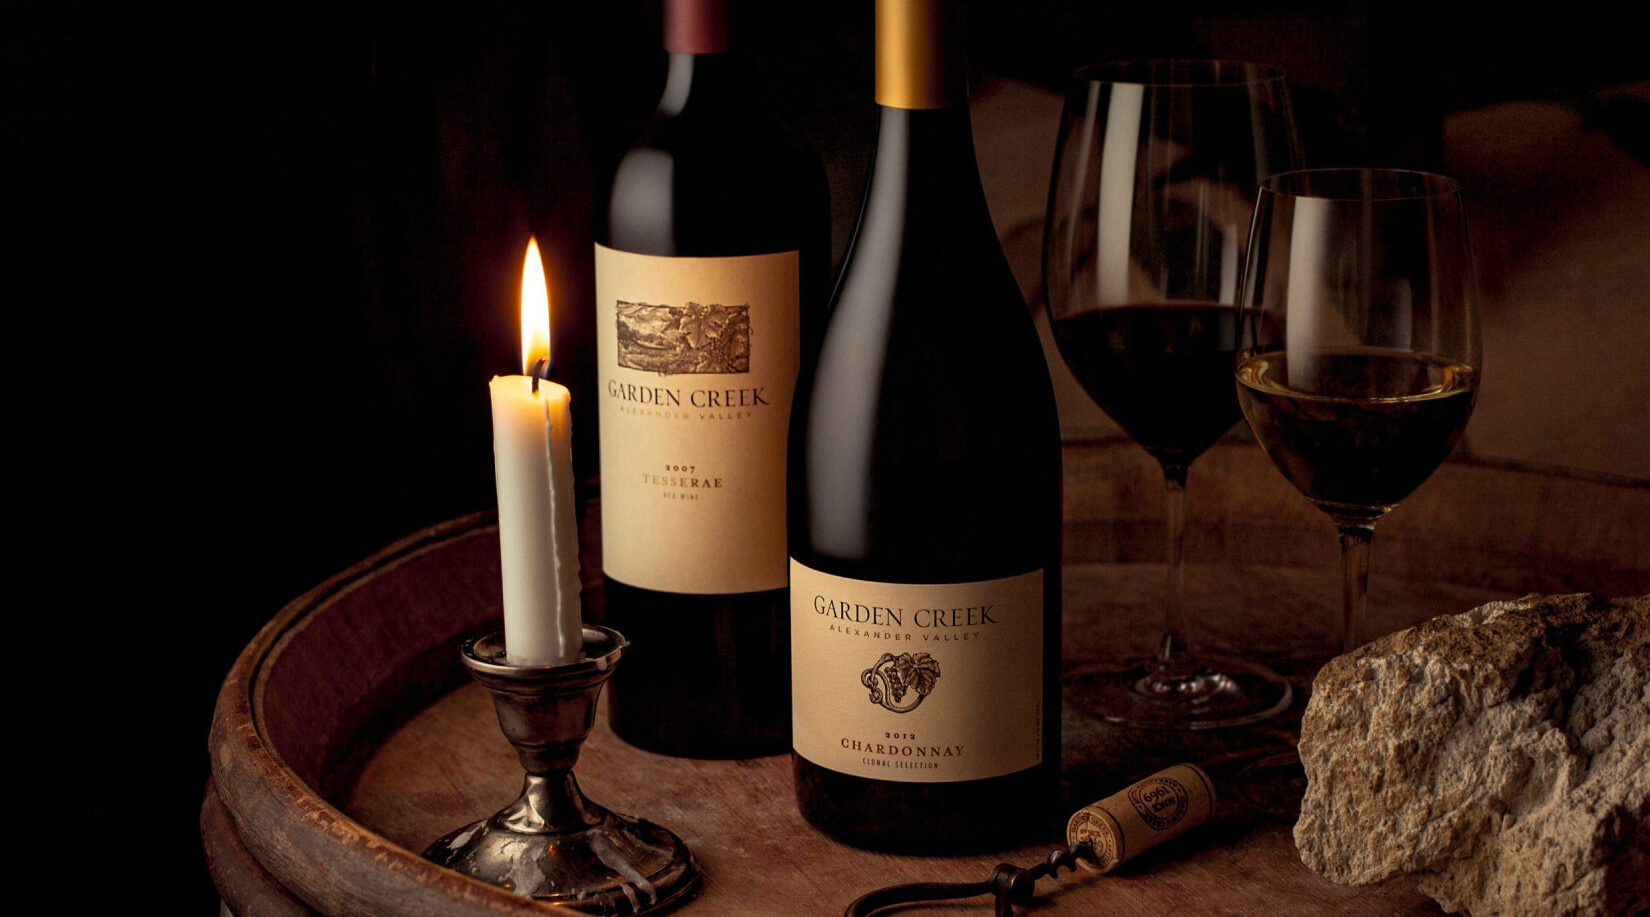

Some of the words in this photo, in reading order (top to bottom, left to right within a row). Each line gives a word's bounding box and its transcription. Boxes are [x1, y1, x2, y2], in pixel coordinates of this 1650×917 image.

[608, 379, 680, 406] GARDEN
[690, 387, 770, 408] CREEK
[620, 405, 689, 419] ALEXANDER
[699, 411, 752, 420] VALLEY
[665, 464, 695, 473] 2007
[642, 474, 723, 488] TESSERAE
[814, 595, 903, 627] GARDEN
[914, 605, 999, 628] CREEK
[829, 625, 912, 641] ALEXANDER
[923, 631, 980, 641] VALLEY
[885, 732, 916, 740] 2012
[841, 738, 965, 757] CHARDONNAY
[862, 758, 891, 769] CLONAL
[896, 759, 939, 769] SELECTION
[1144, 785, 1171, 803] 1969
